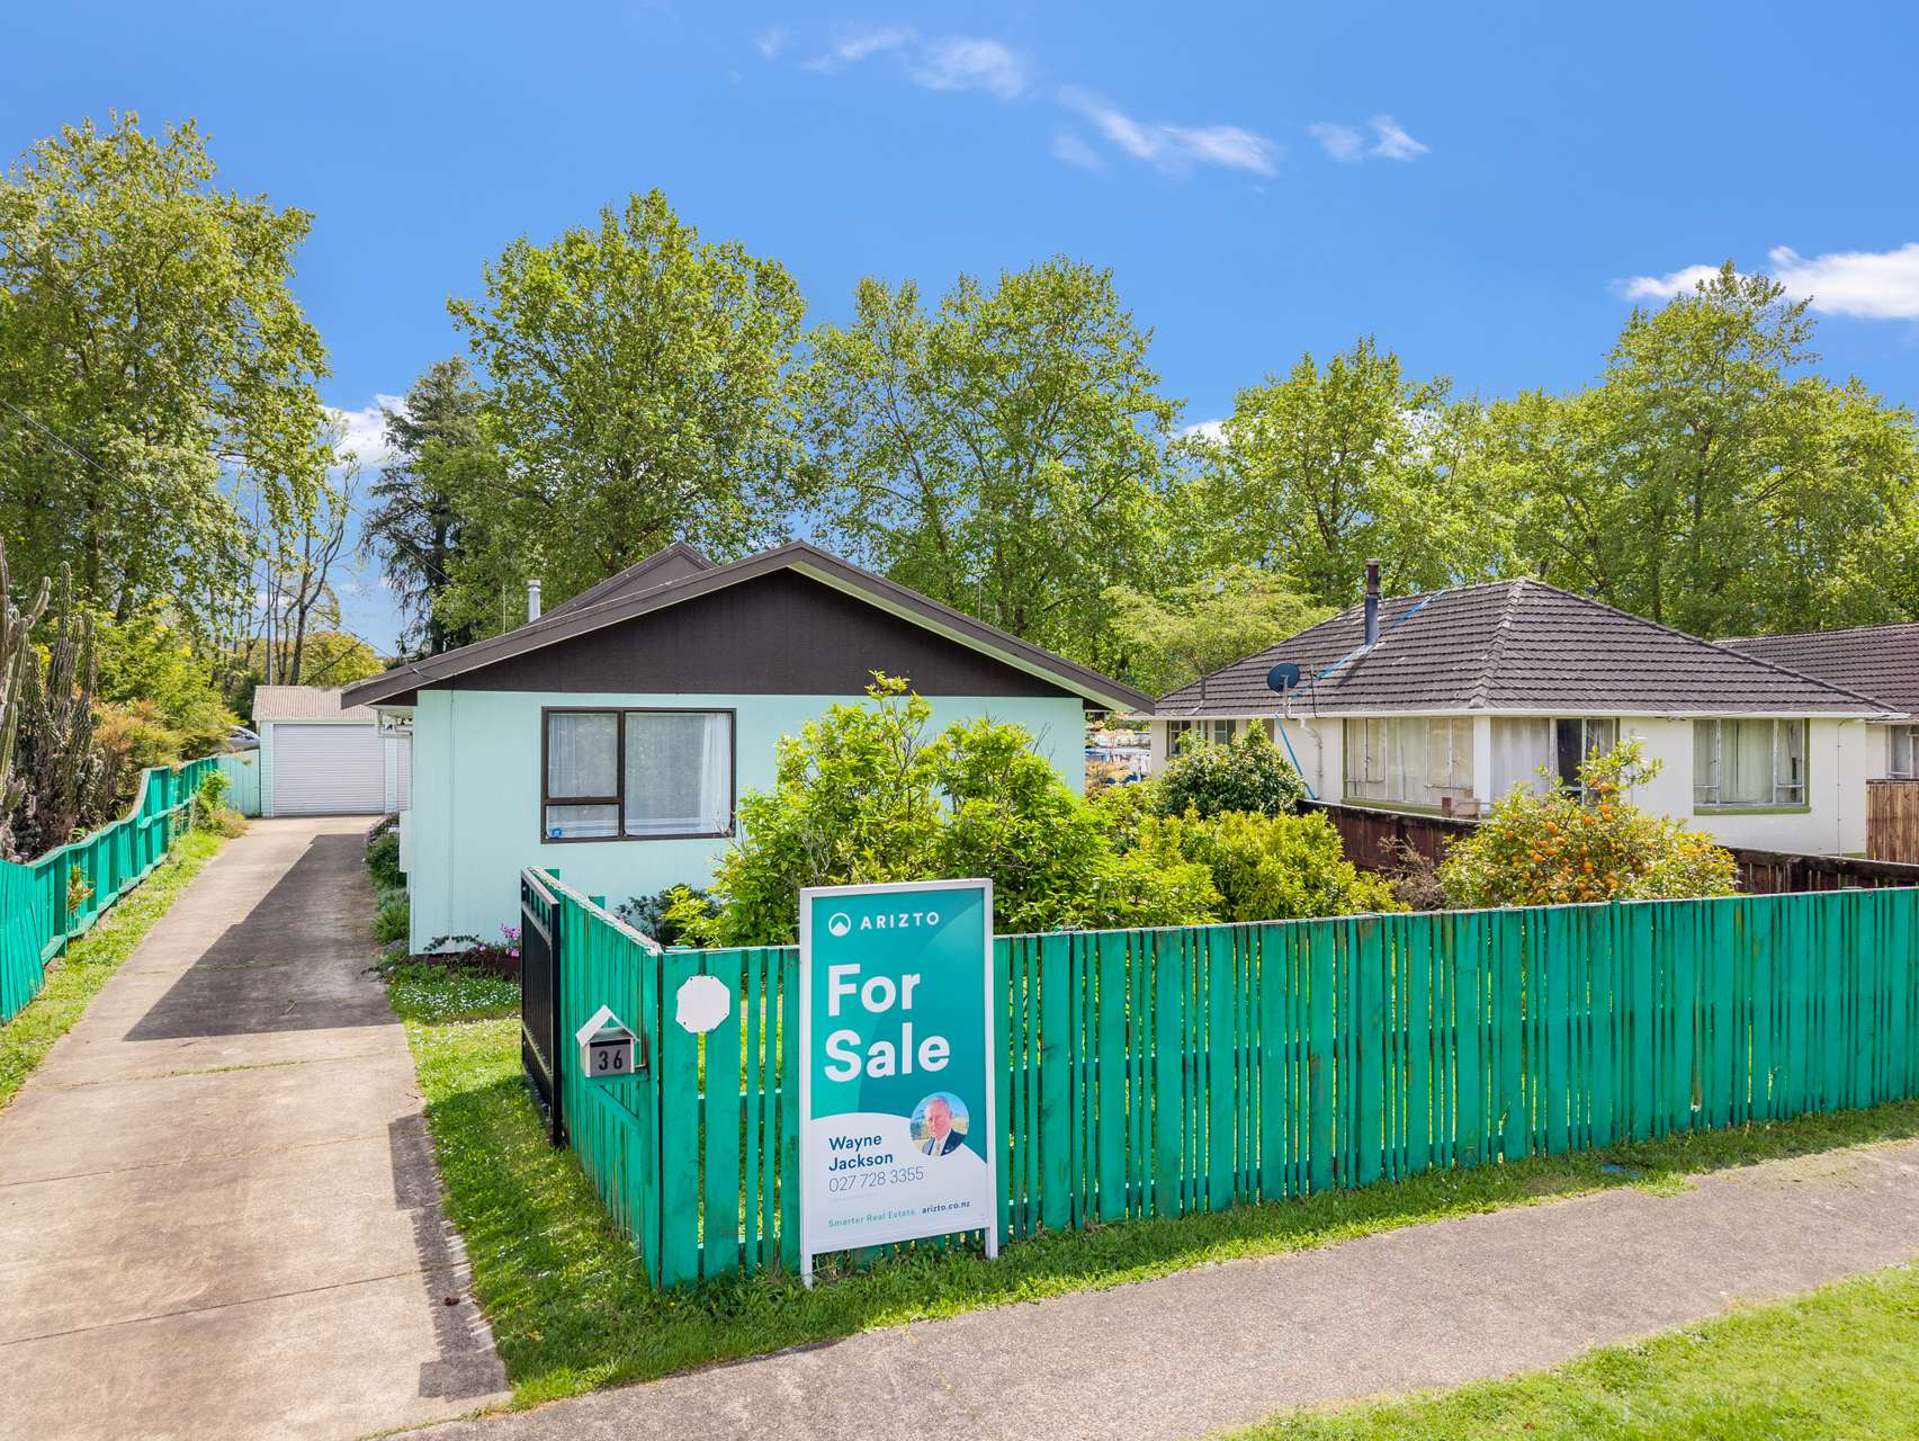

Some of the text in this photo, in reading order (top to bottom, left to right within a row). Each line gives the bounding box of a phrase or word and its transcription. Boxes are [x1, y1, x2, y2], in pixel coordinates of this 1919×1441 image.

[860, 911, 940, 930] ARIZTO
[828, 963, 921, 1017] For
[598, 1050, 623, 1070] 36
[824, 1022, 950, 1082] Sale
[829, 1135, 882, 1152] Wayne
[829, 1153, 893, 1171] Jackson
[829, 1165, 925, 1192] 027 728 3355
[828, 1200, 970, 1228] Smarter Real Estate arizto.co.nz
